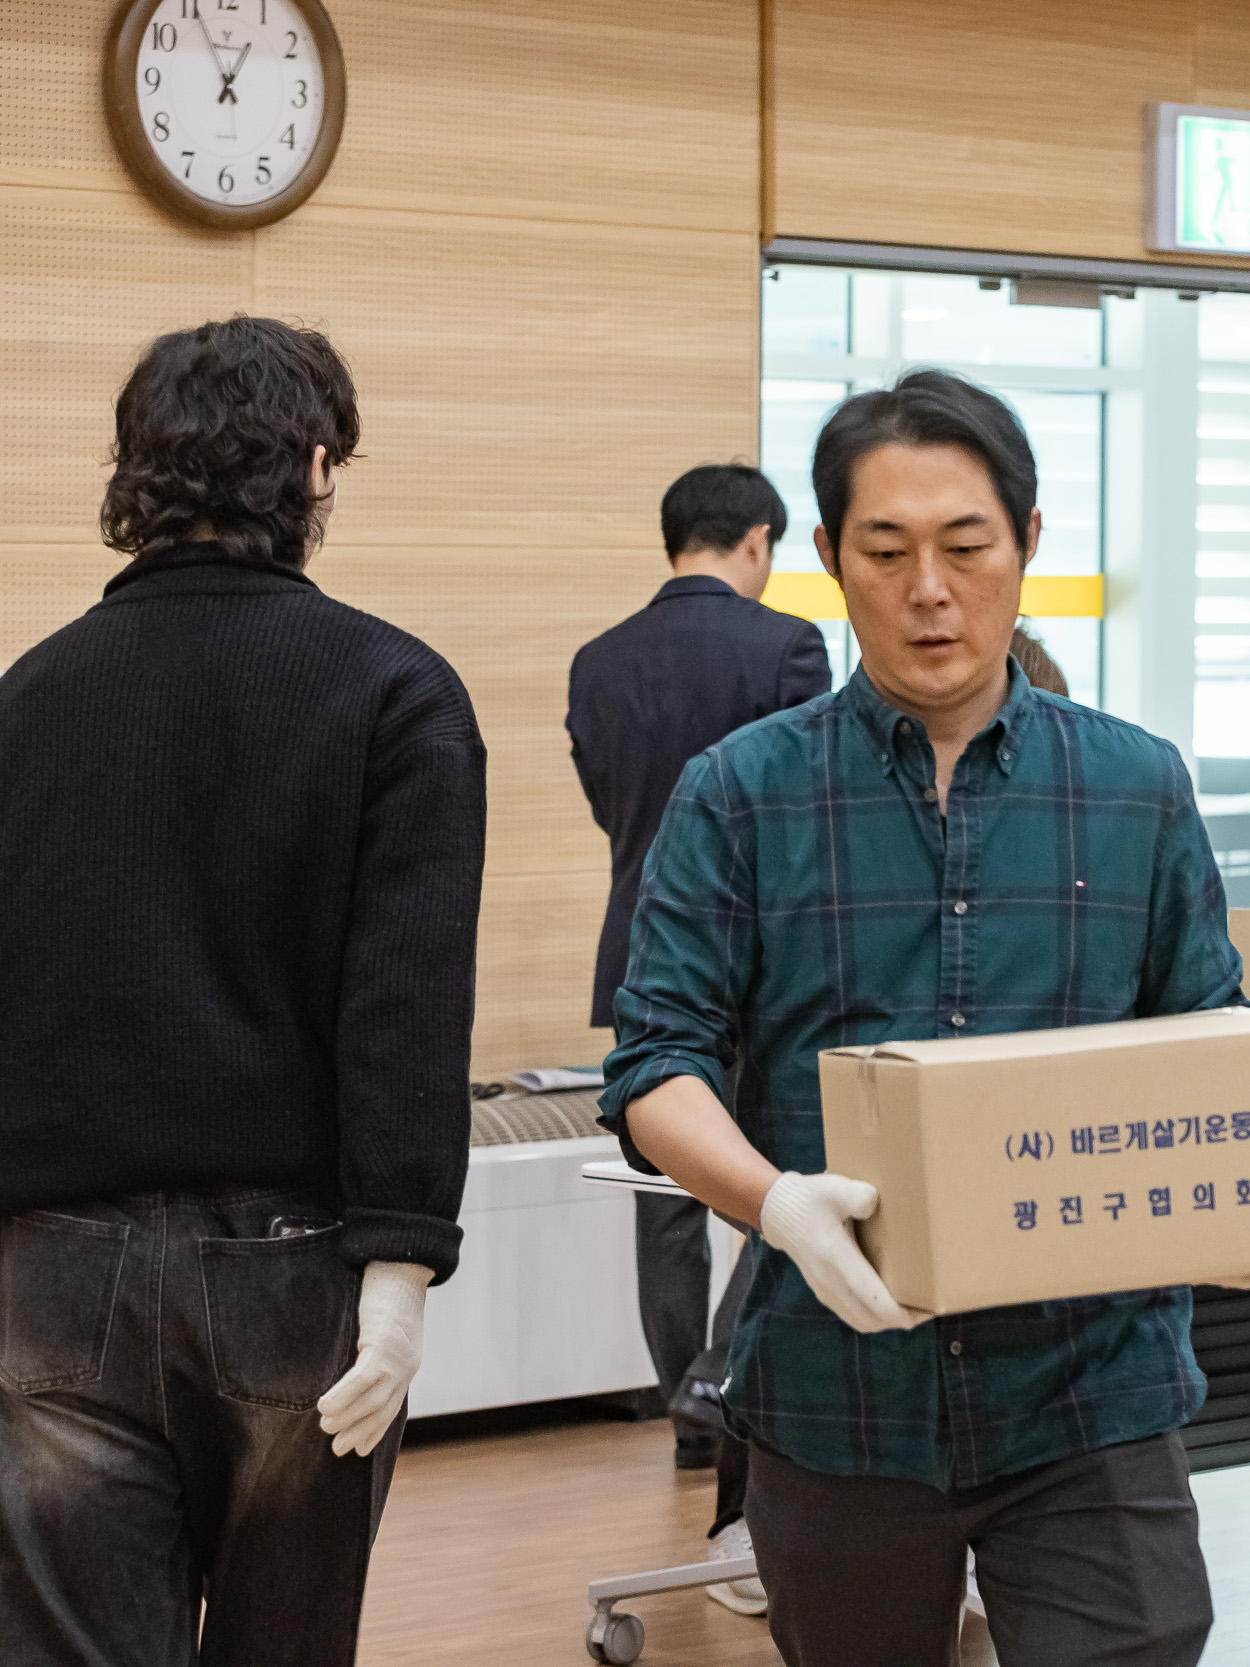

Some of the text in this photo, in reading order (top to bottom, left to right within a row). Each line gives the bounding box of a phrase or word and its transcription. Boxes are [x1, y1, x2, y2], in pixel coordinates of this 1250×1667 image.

[152, 22, 177, 52] 10
[283, 31, 298, 59] 2
[144, 67, 161, 96] 9
[291, 79, 308, 109] 3
[153, 111, 170, 142] 8
[279, 122, 296, 150] 4
[180, 151, 195, 179] 7
[217, 165, 235, 193] 6
[255, 156, 272, 185] 5
[1004, 1129, 1054, 1163] (사)
